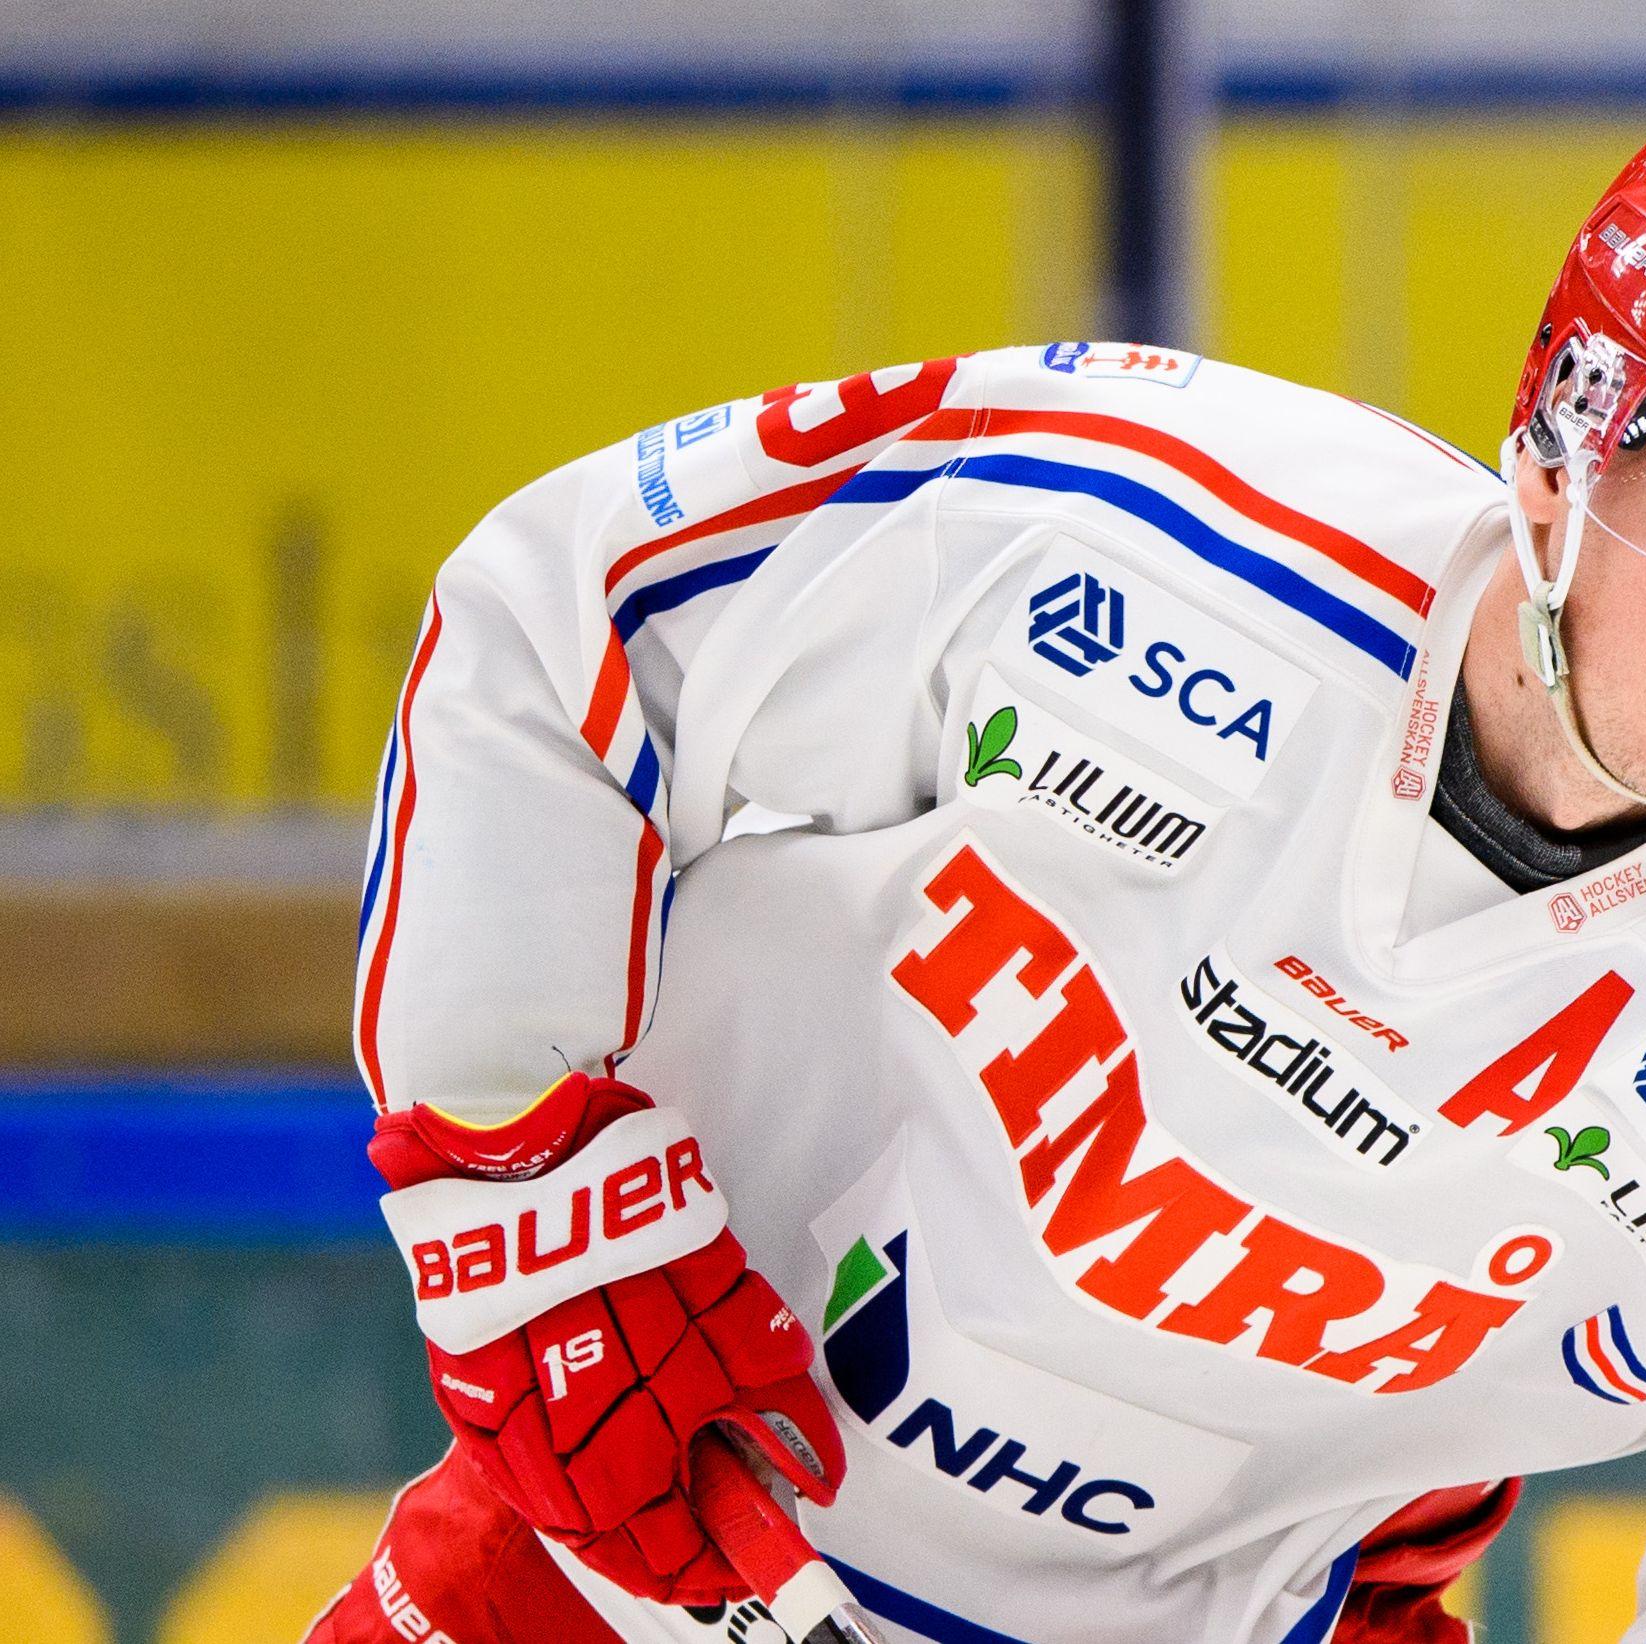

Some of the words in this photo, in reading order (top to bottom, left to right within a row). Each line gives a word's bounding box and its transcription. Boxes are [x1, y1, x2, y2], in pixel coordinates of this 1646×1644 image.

[1559, 407, 1590, 431] BAUER
[1128, 641, 1273, 762] SCA
[1412, 700, 1440, 768] HOCKEY
[1028, 750, 1206, 860] LILIUM
[1580, 862, 1643, 903] HOCKEY
[1273, 955, 1410, 1054] BAUER
[1437, 969, 1636, 1138] A
[890, 844, 1554, 1395] TIMRÅ
[412, 1137, 714, 1301] BAUER
[886, 1397, 1155, 1535] NHC
[373, 1545, 459, 1644] AUE
